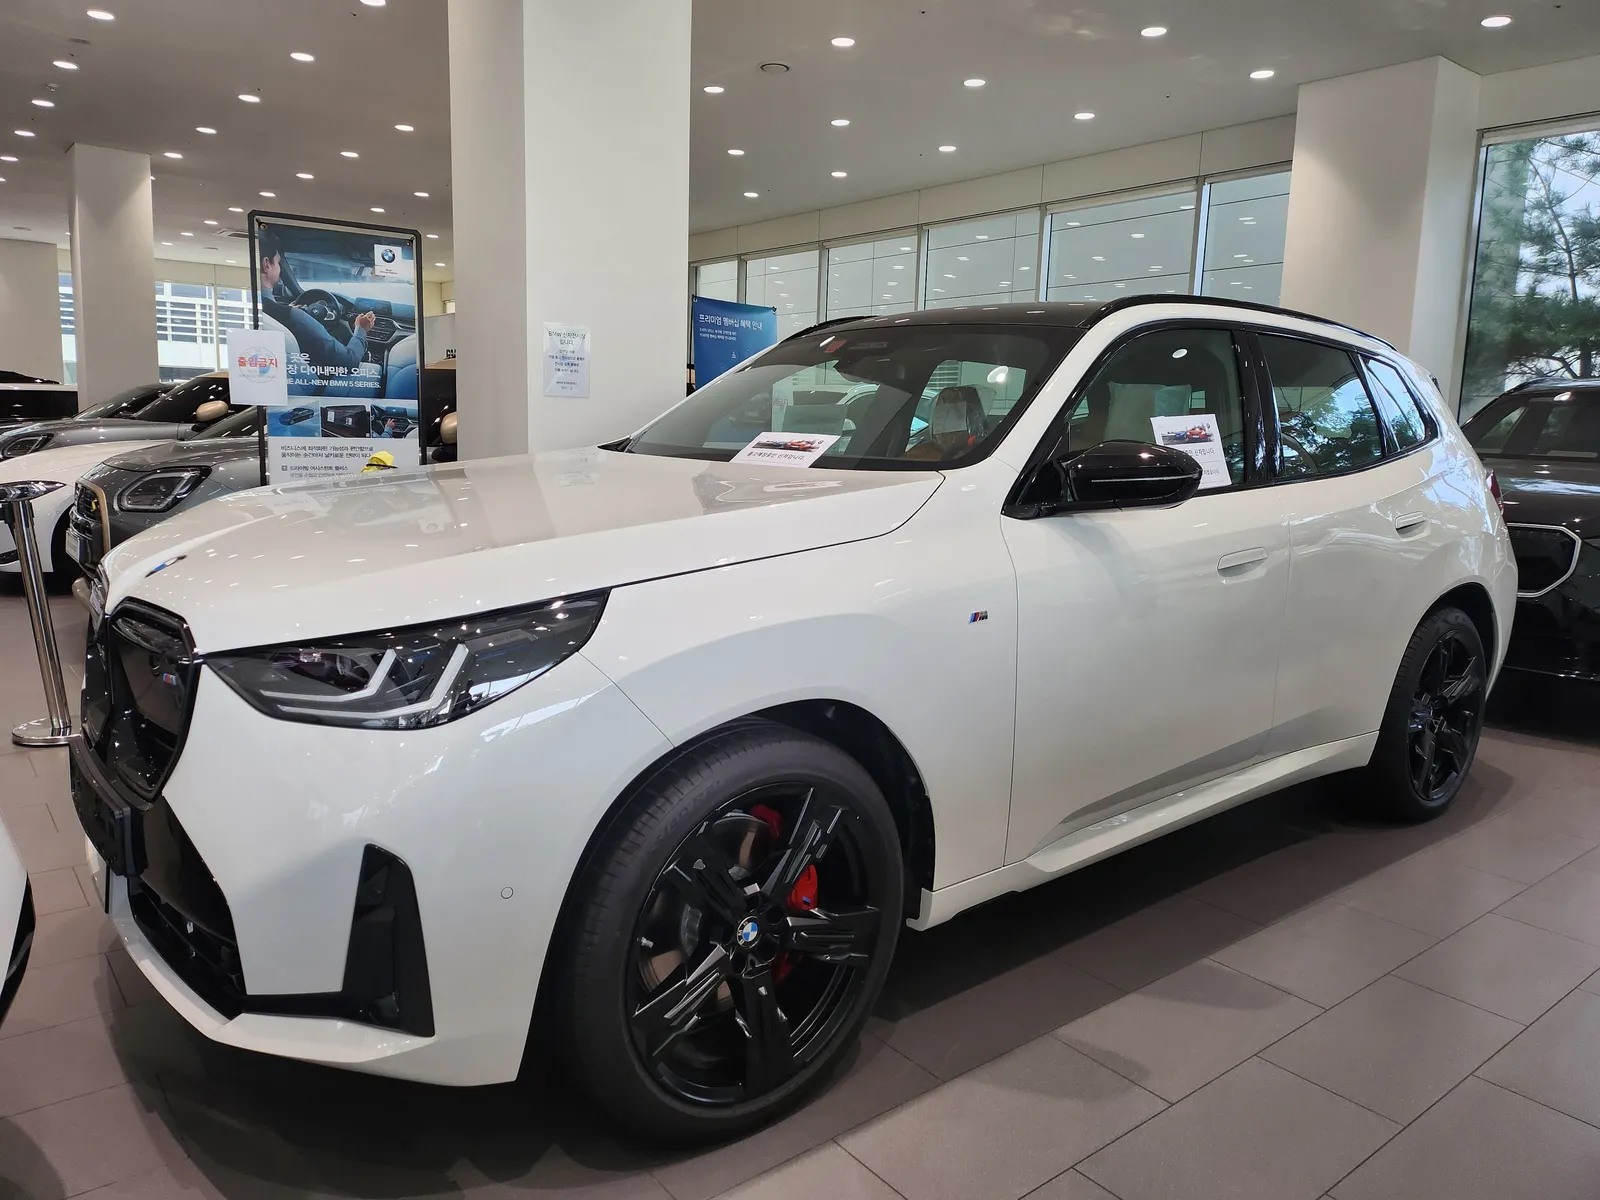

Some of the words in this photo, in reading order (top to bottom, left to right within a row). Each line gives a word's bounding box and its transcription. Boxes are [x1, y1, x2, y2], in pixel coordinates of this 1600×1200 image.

[699, 314, 721, 326] 프리미엄
[723, 317, 739, 328] 멤버십
[740, 320, 751, 329] 혜택
[752, 321, 763, 331] 안내
[237, 356, 278, 368] 출입금지
[290, 353, 310, 364] 곳은
[286, 364, 298, 375] 장
[300, 365, 348, 377] 다이내믹한
